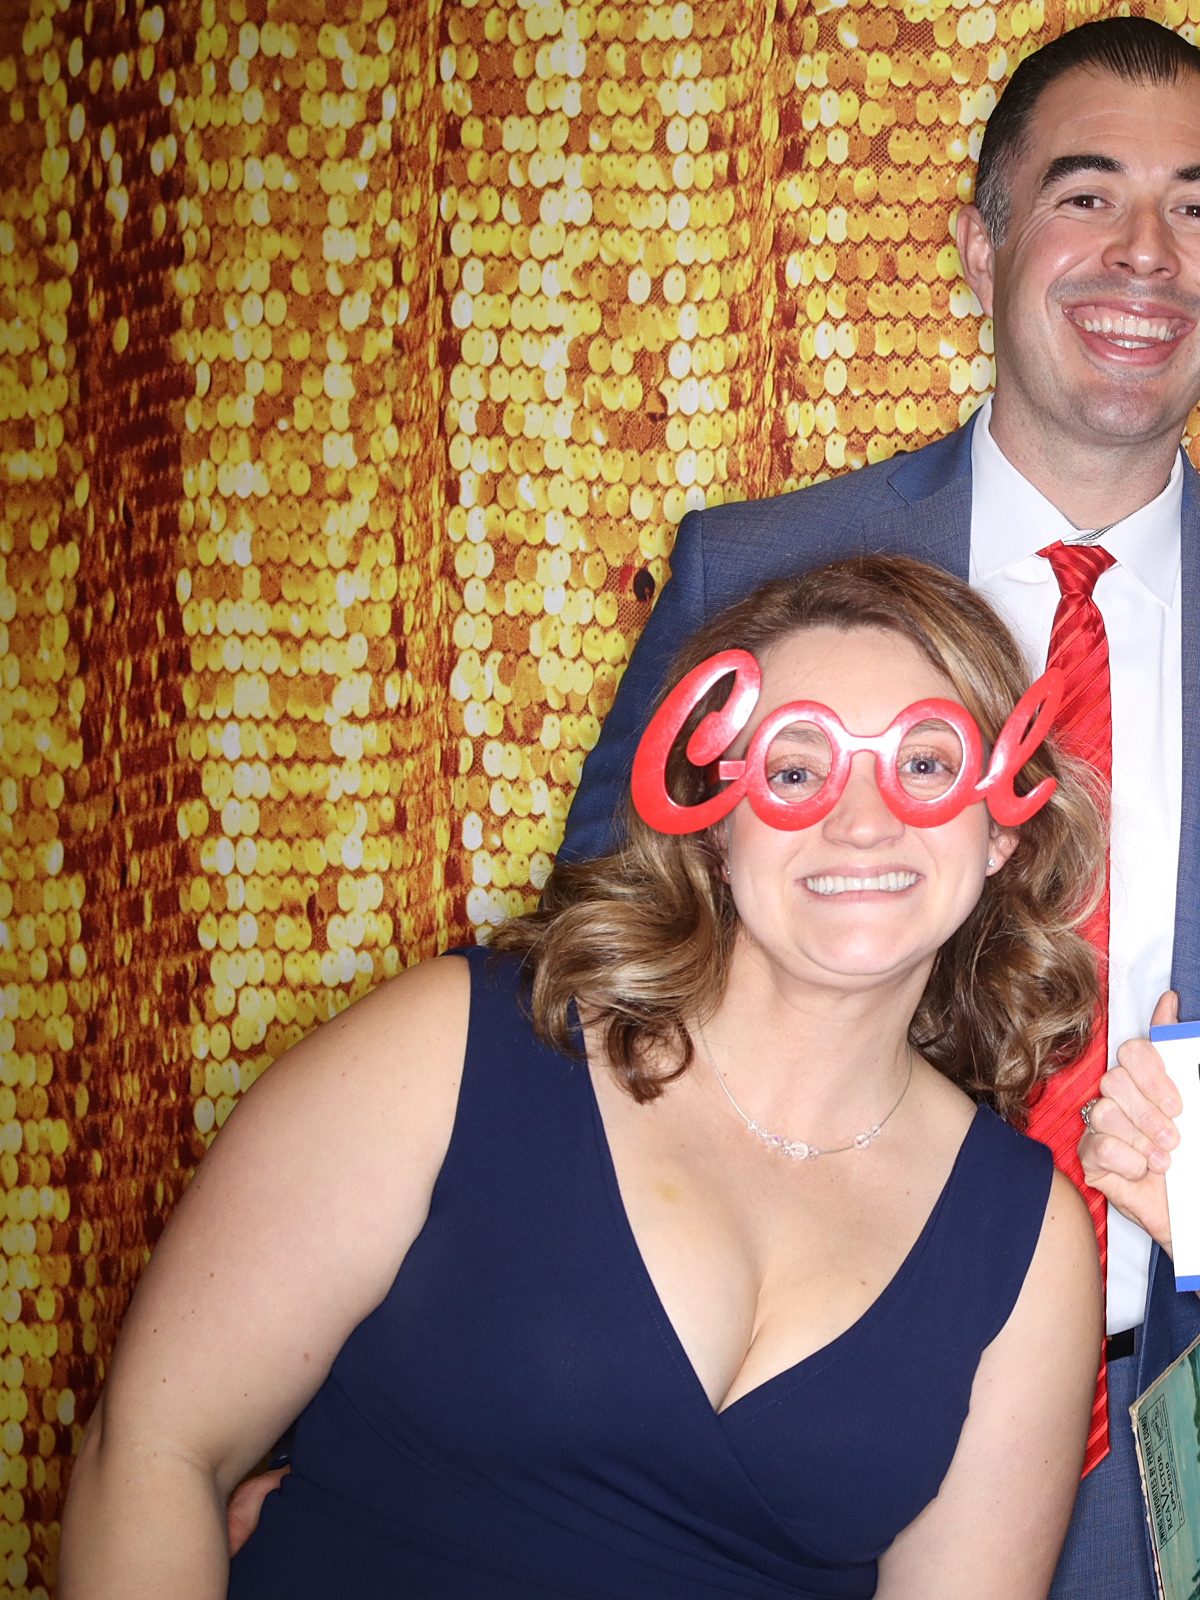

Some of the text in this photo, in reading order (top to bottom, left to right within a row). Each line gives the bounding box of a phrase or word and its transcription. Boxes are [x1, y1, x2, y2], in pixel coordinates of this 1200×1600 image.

[631, 649, 1065, 835] Cool
[1141, 1415, 1166, 1546] SWING FAVORITES BY PERRY COMO
